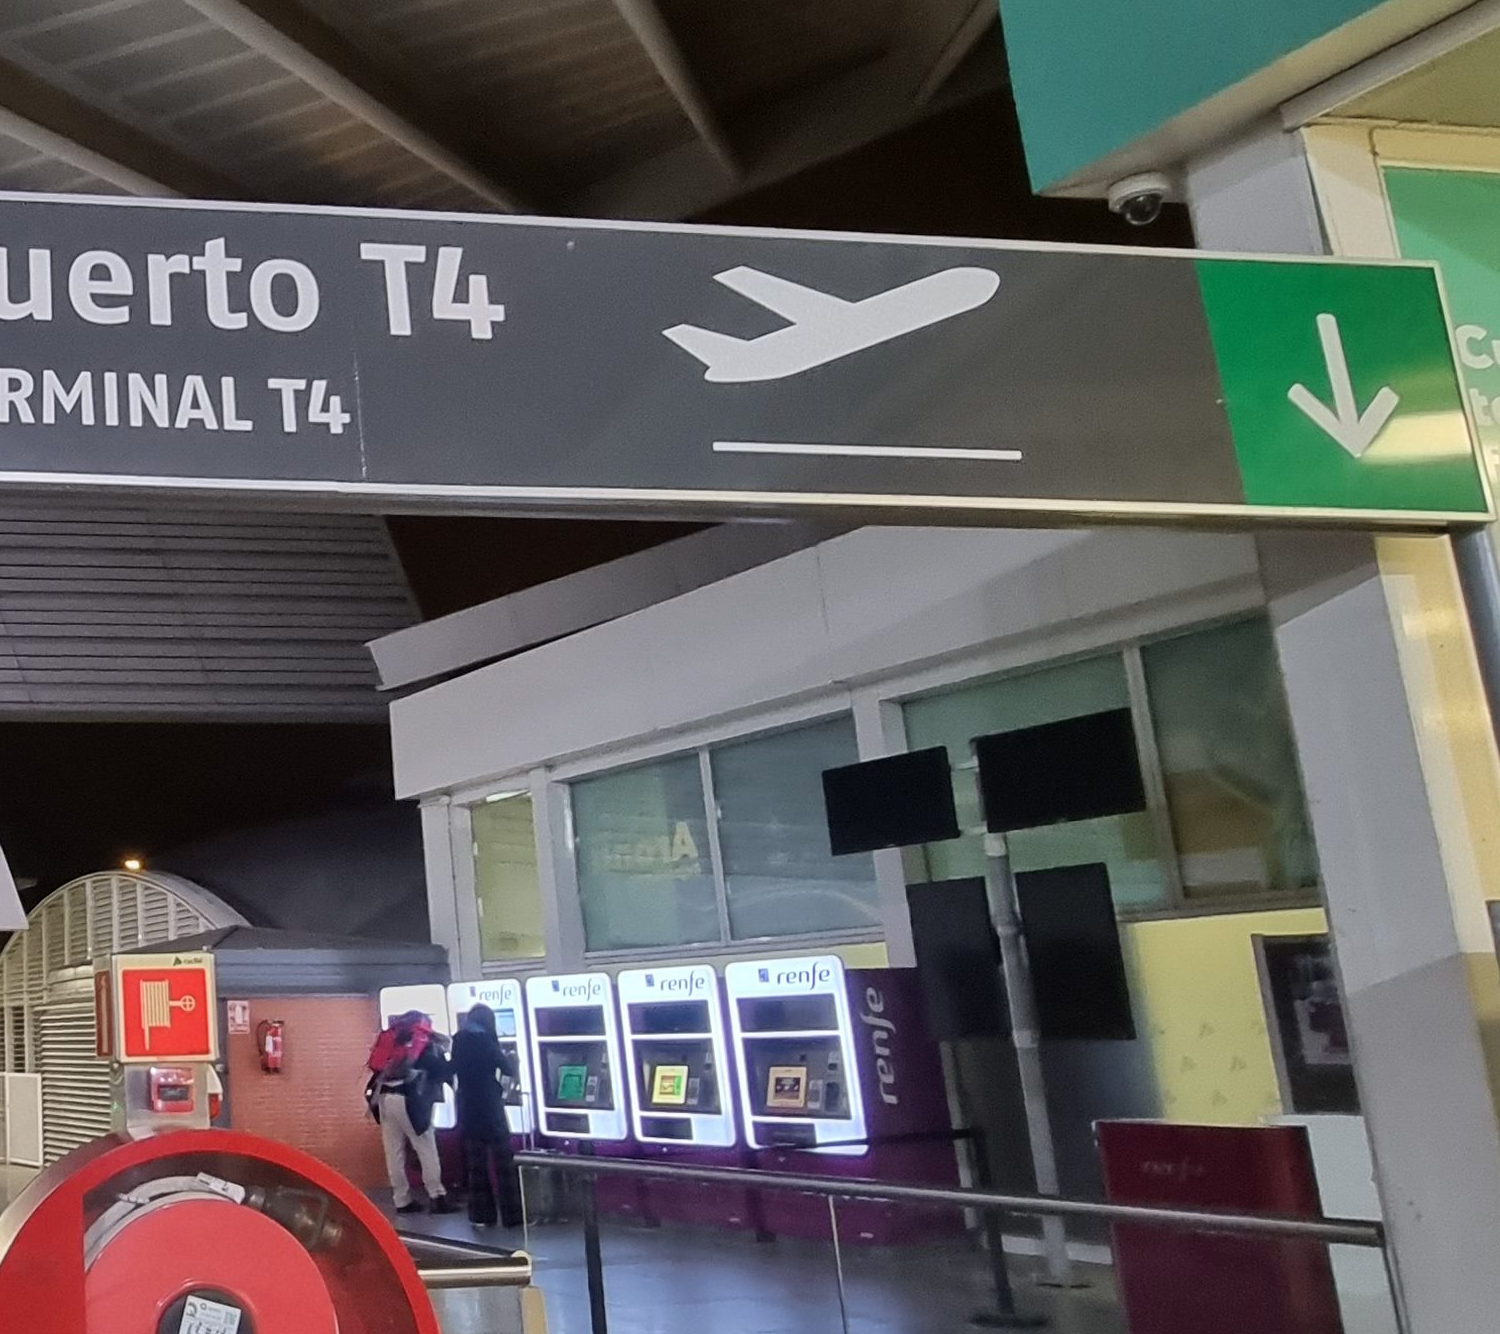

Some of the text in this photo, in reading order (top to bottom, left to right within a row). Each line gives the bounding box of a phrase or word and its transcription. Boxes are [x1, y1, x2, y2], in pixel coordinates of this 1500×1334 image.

[360, 243, 505, 339] T4
[1455, 324, 1500, 369] C
[268, 378, 350, 433] T4
[478, 984, 512, 1006] renfe
[562, 978, 601, 1002] renfe
[660, 970, 705, 997] renfe
[777, 962, 831, 991] renfe
[859, 986, 898, 1104] renfe
